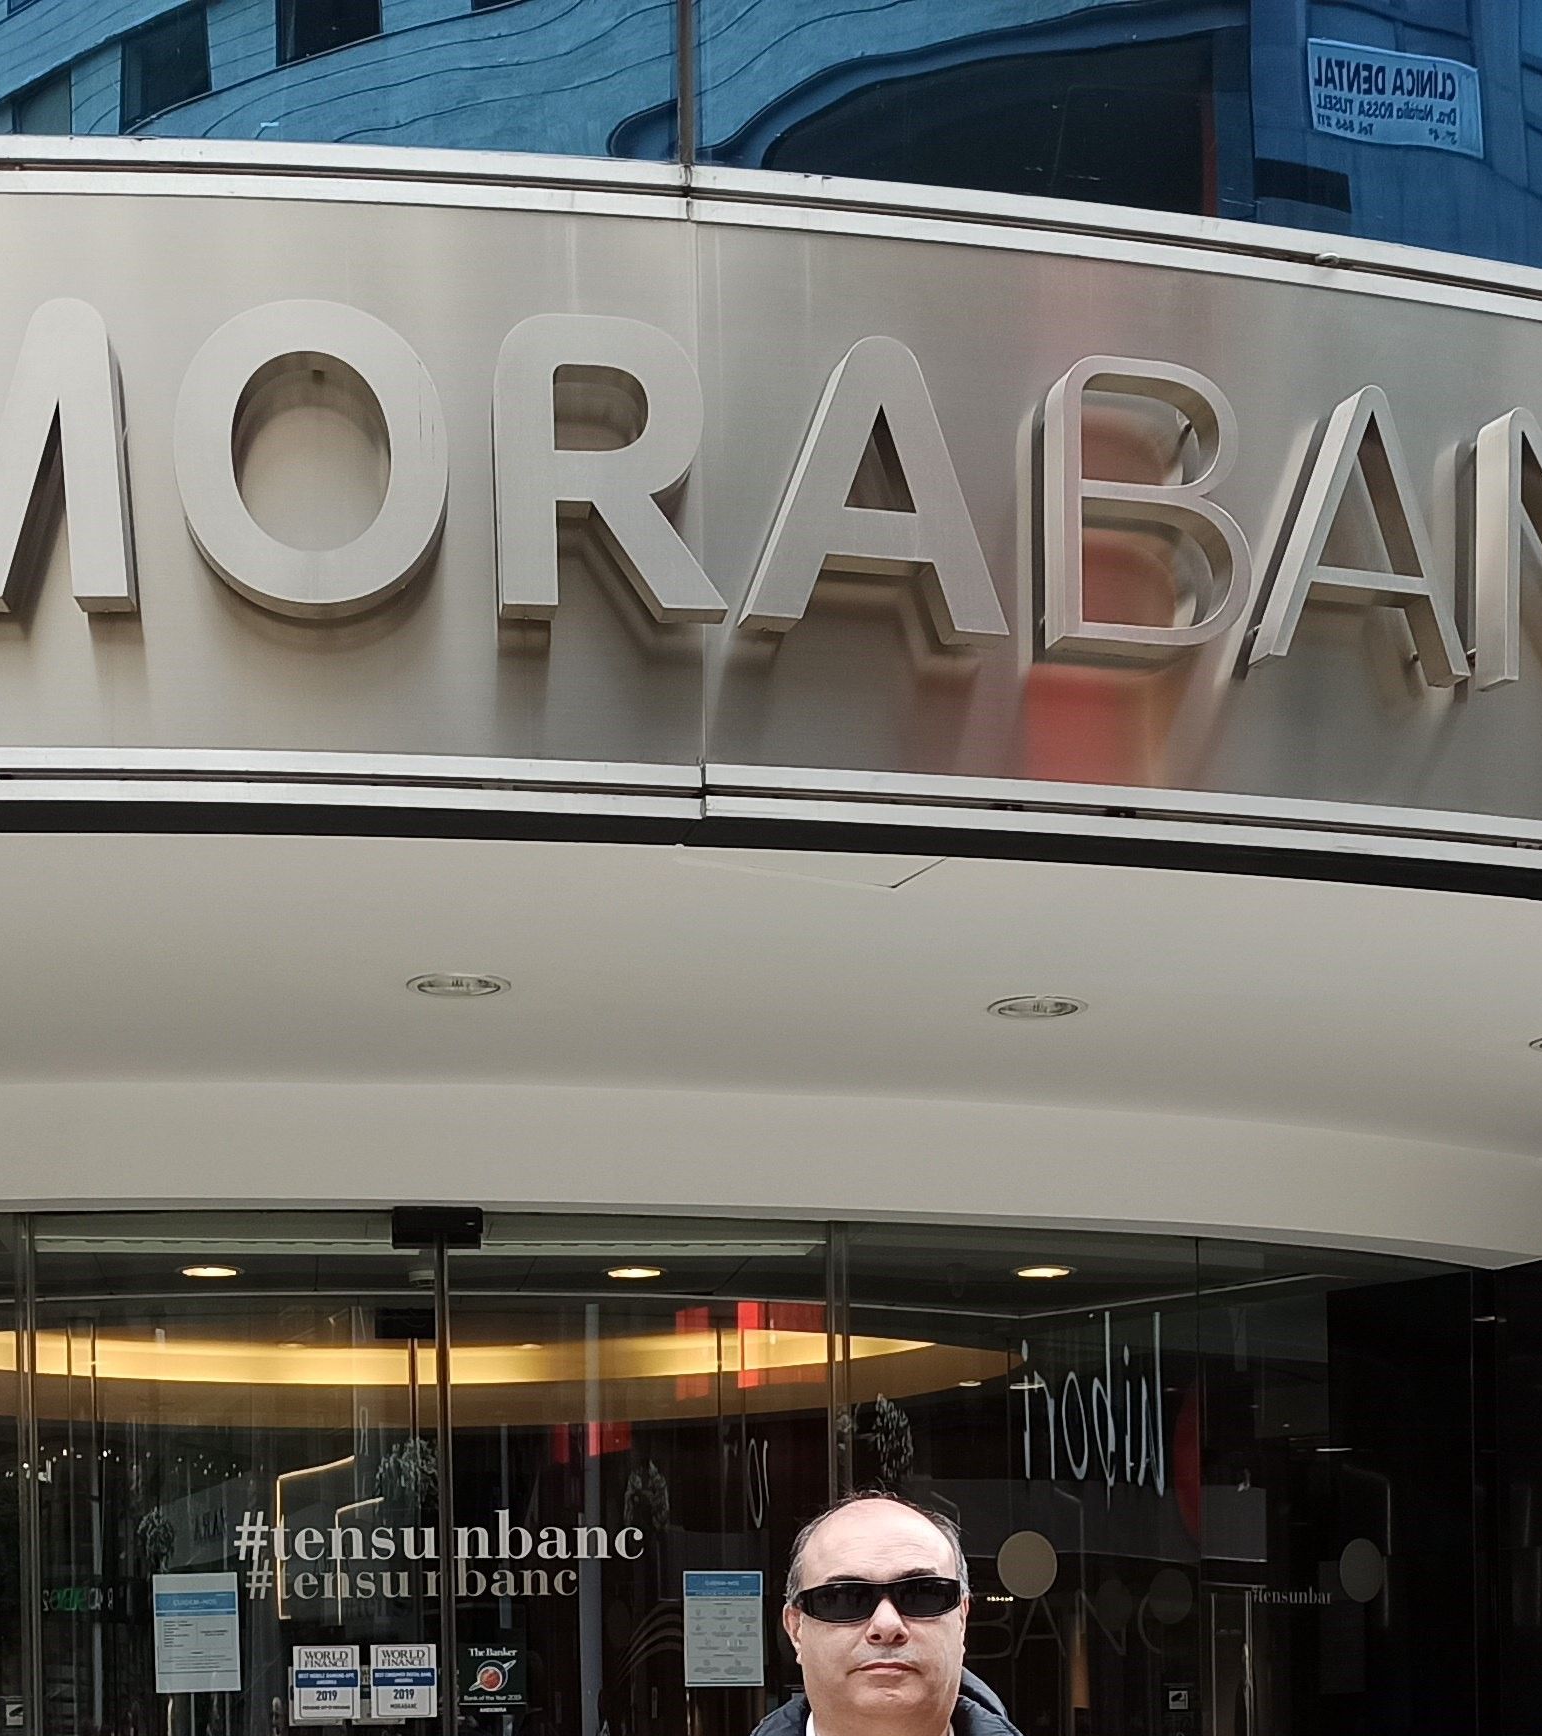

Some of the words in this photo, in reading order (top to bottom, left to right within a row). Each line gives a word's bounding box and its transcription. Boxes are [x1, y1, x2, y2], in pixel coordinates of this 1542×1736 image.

[304, 1650, 348, 1660] WORLD
[381, 1649, 426, 1659] WORLD
[467, 1647, 485, 1657] The
[486, 1646, 518, 1657] Banker
[316, 1690, 338, 1702] 2019
[393, 1689, 415, 1700] 2019
